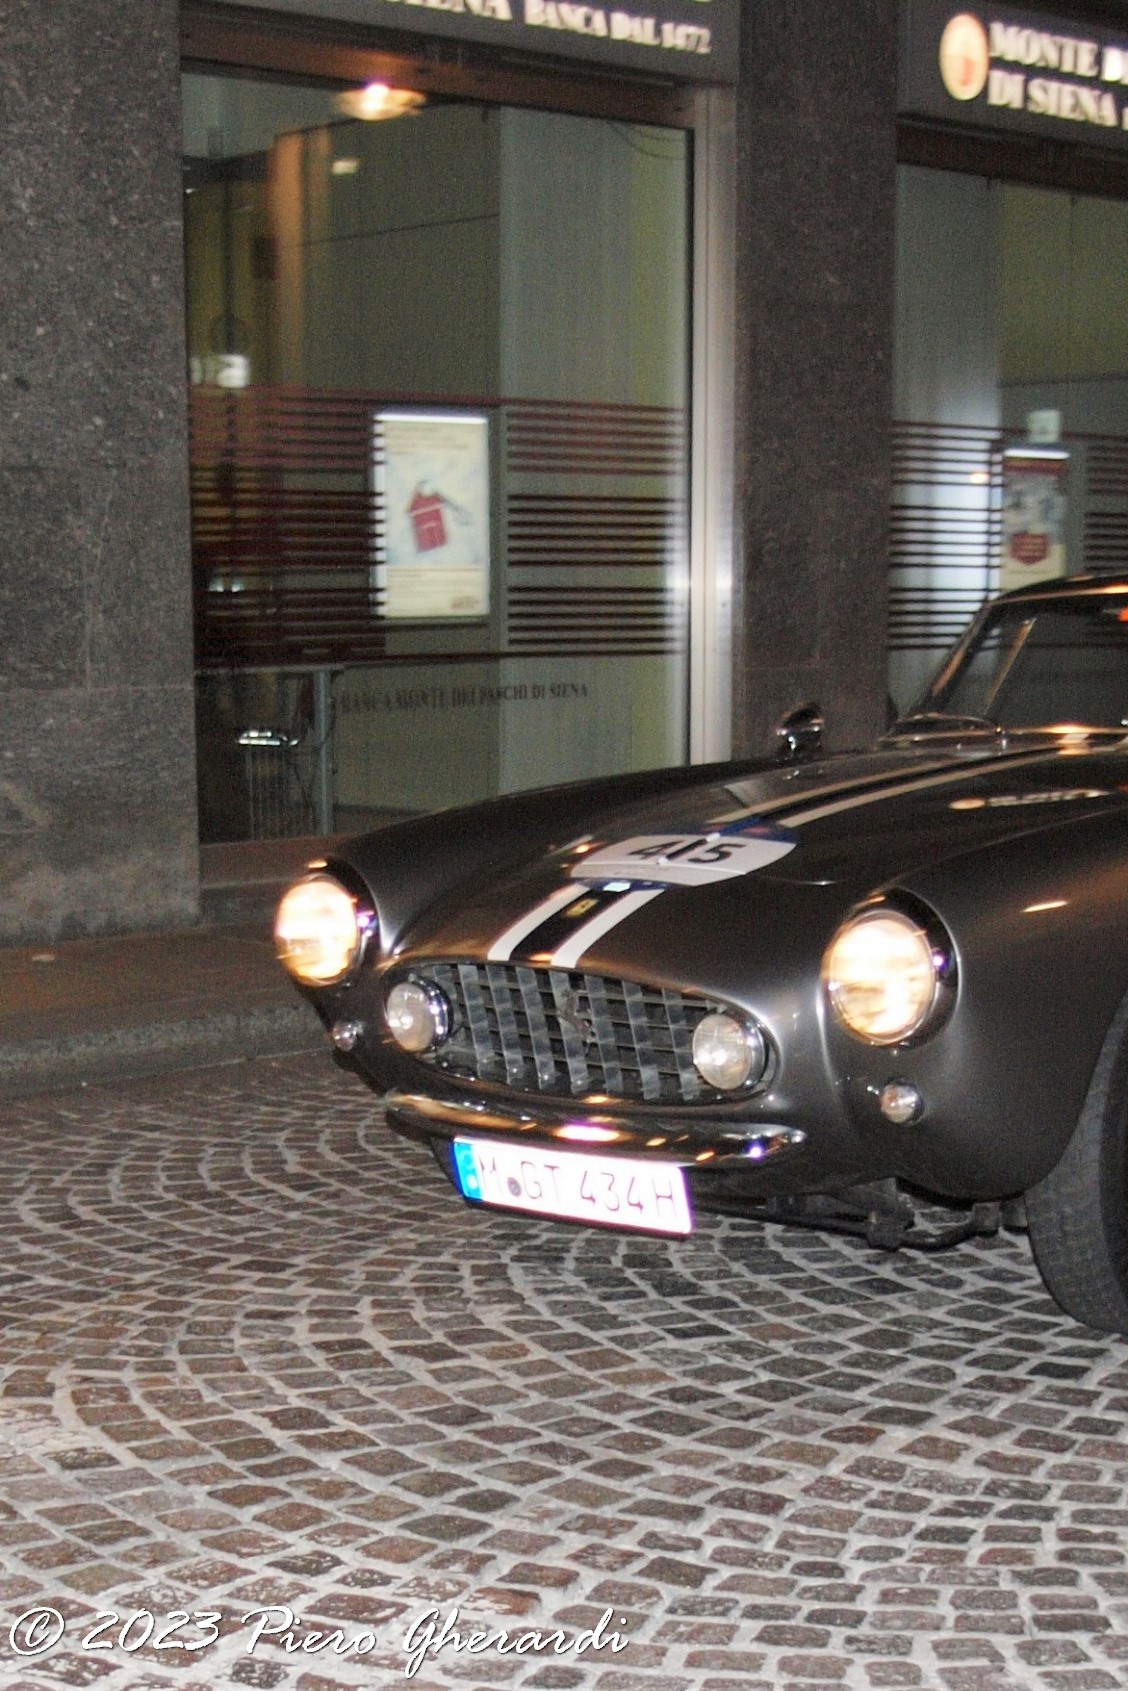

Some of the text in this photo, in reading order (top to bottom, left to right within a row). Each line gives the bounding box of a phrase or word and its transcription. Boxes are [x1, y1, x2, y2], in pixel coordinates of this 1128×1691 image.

[988, 22, 1098, 77] MONTE
[987, 69, 1025, 109] DI
[1027, 78, 1118, 127] SIENA
